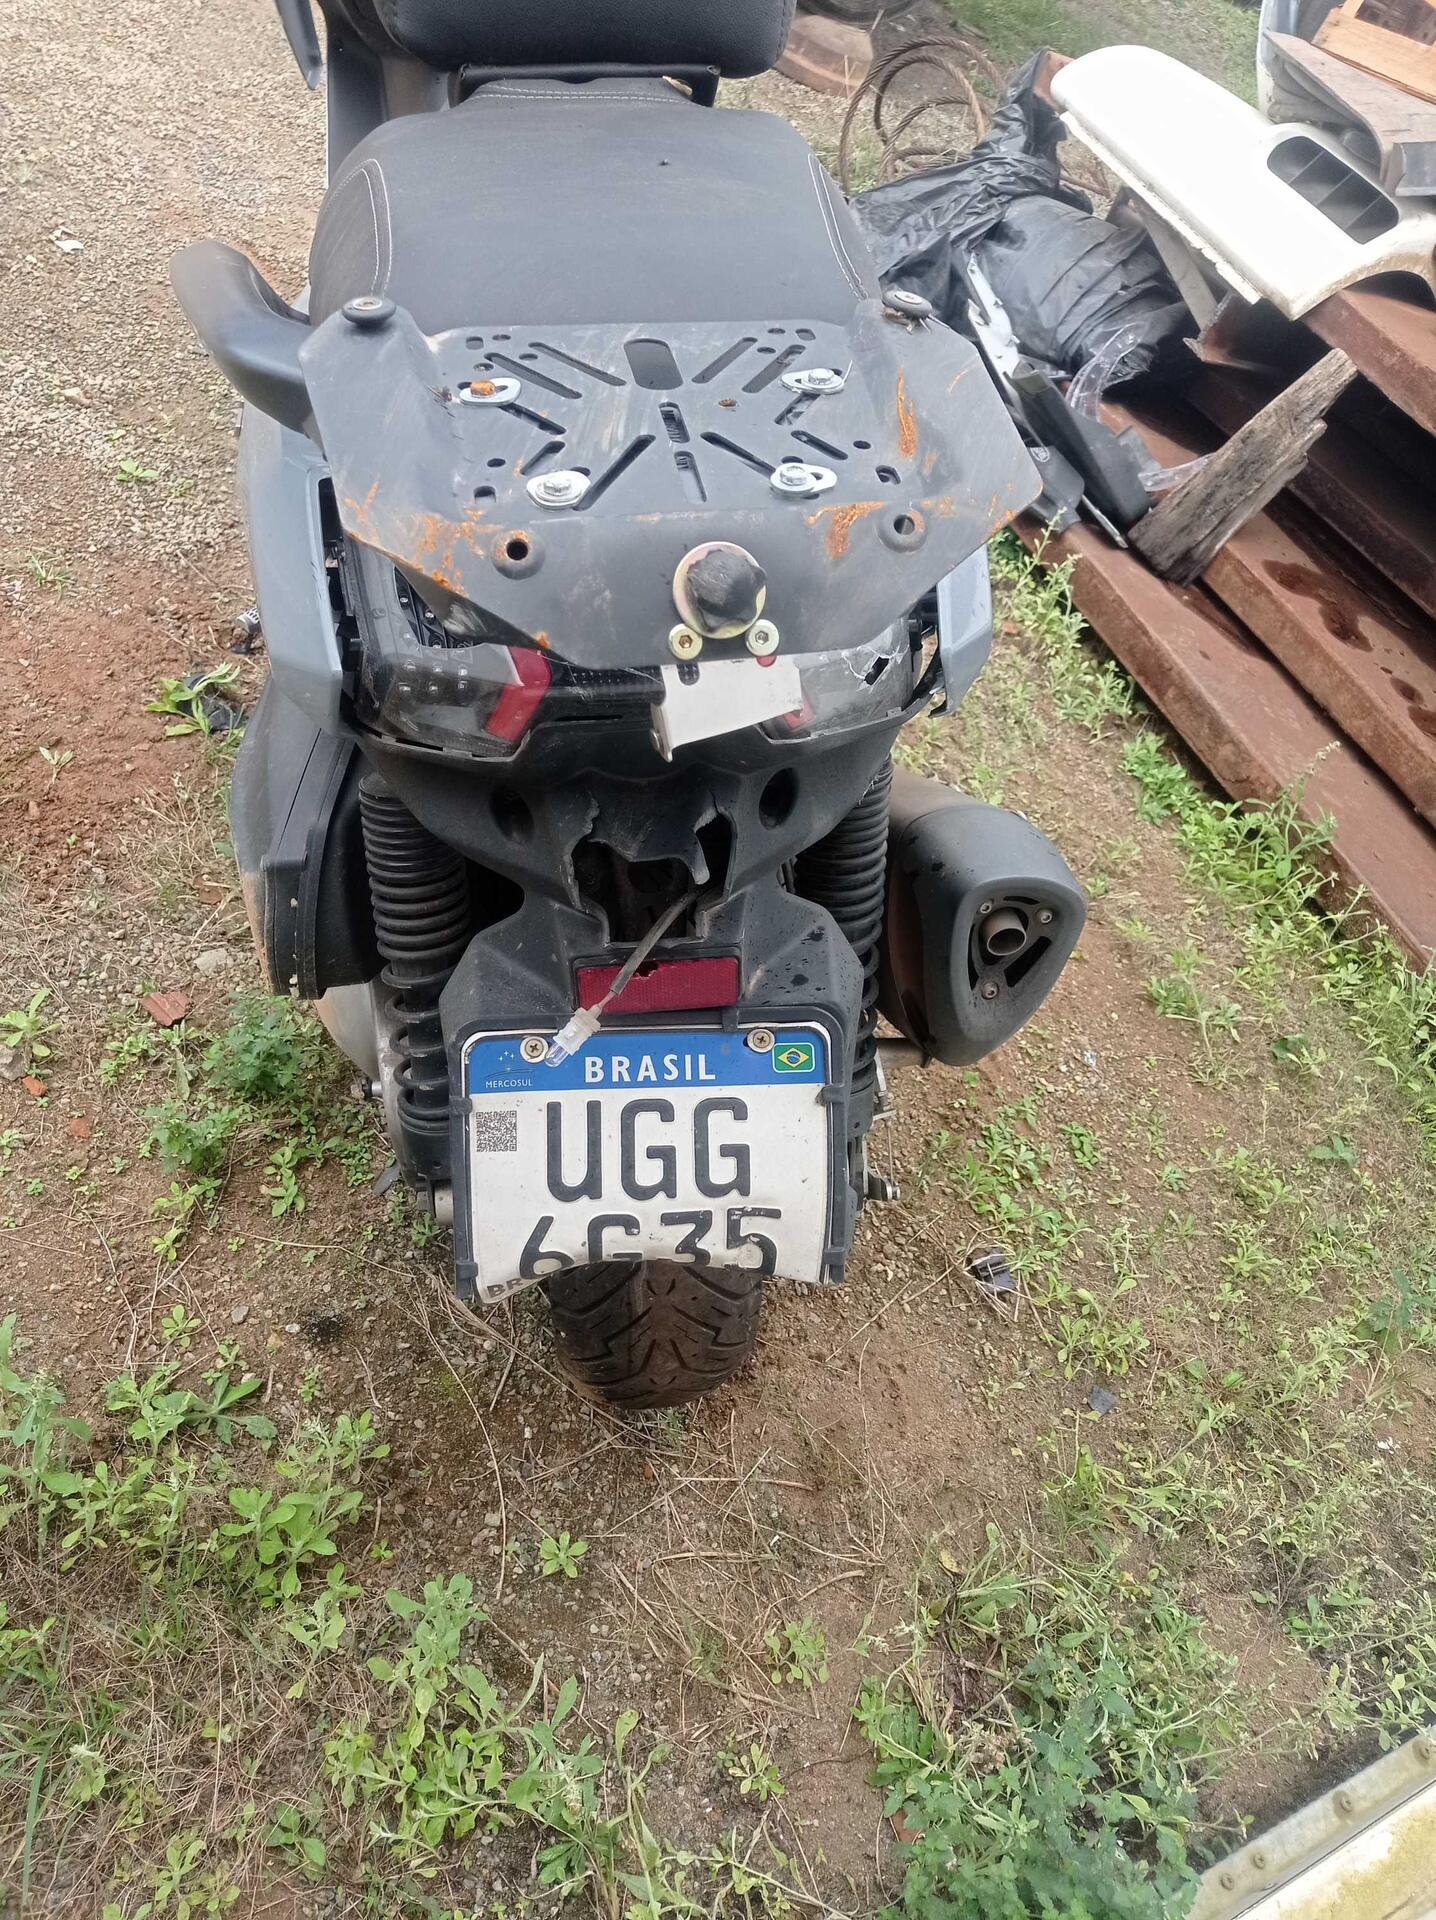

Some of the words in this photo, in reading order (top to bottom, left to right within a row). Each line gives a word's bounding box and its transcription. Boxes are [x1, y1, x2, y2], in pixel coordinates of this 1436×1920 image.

[485, 1079, 533, 1089] MERCOSUL
[584, 1053, 717, 1083] BRASIL
[546, 1096, 751, 1200] UGG
[518, 1206, 783, 1280] 6G35
